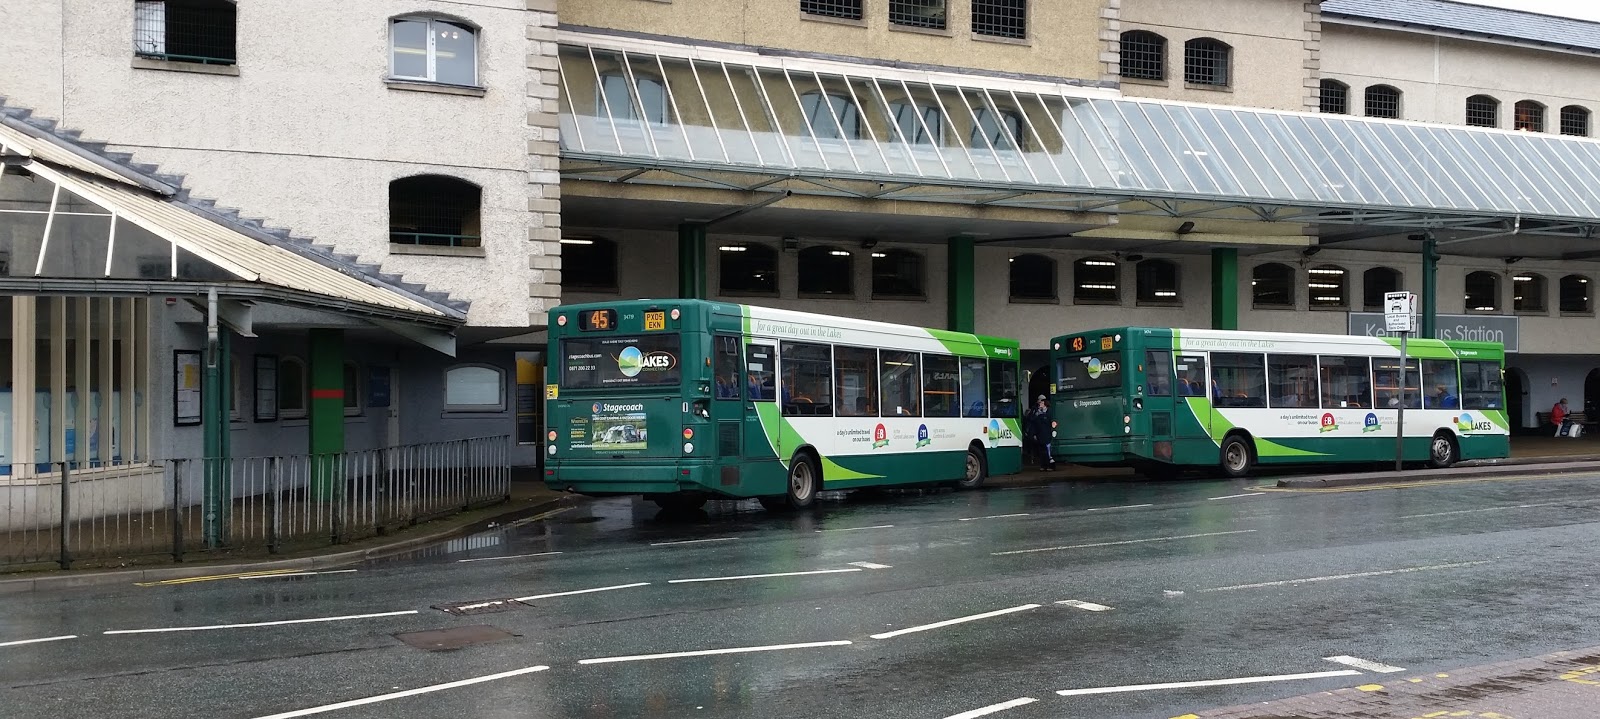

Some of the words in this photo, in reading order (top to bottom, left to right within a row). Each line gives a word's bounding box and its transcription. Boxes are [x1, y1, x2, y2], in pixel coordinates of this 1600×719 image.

[591, 310, 608, 329] 45
[646, 313, 664, 321] PX05
[648, 321, 662, 329] EKN
[756, 320, 765, 333] for
[767, 324, 772, 332] a
[772, 325, 787, 335] great
[788, 323, 798, 337] day
[800, 327, 810, 336] out
[811, 326, 817, 336] in
[817, 327, 826, 338] the
[827, 328, 843, 339] Lakes
[1456, 324, 1504, 343] Station
[1072, 336, 1083, 351] 43
[1185, 337, 1194, 348] for
[1200, 339, 1216, 348] great
[1216, 338, 1229, 349] day
[1258, 340, 1276, 348] Lakes
[638, 354, 669, 368] LAKES
[603, 403, 643, 414] Stagecoach
[1079, 400, 1101, 408] Stagecoach
[1324, 416, 1332, 425] £8
[1367, 417, 1376, 425] £11
[1471, 420, 1491, 431] LAKES
[877, 429, 884, 439] £8
[998, 429, 1012, 440] LAKES
